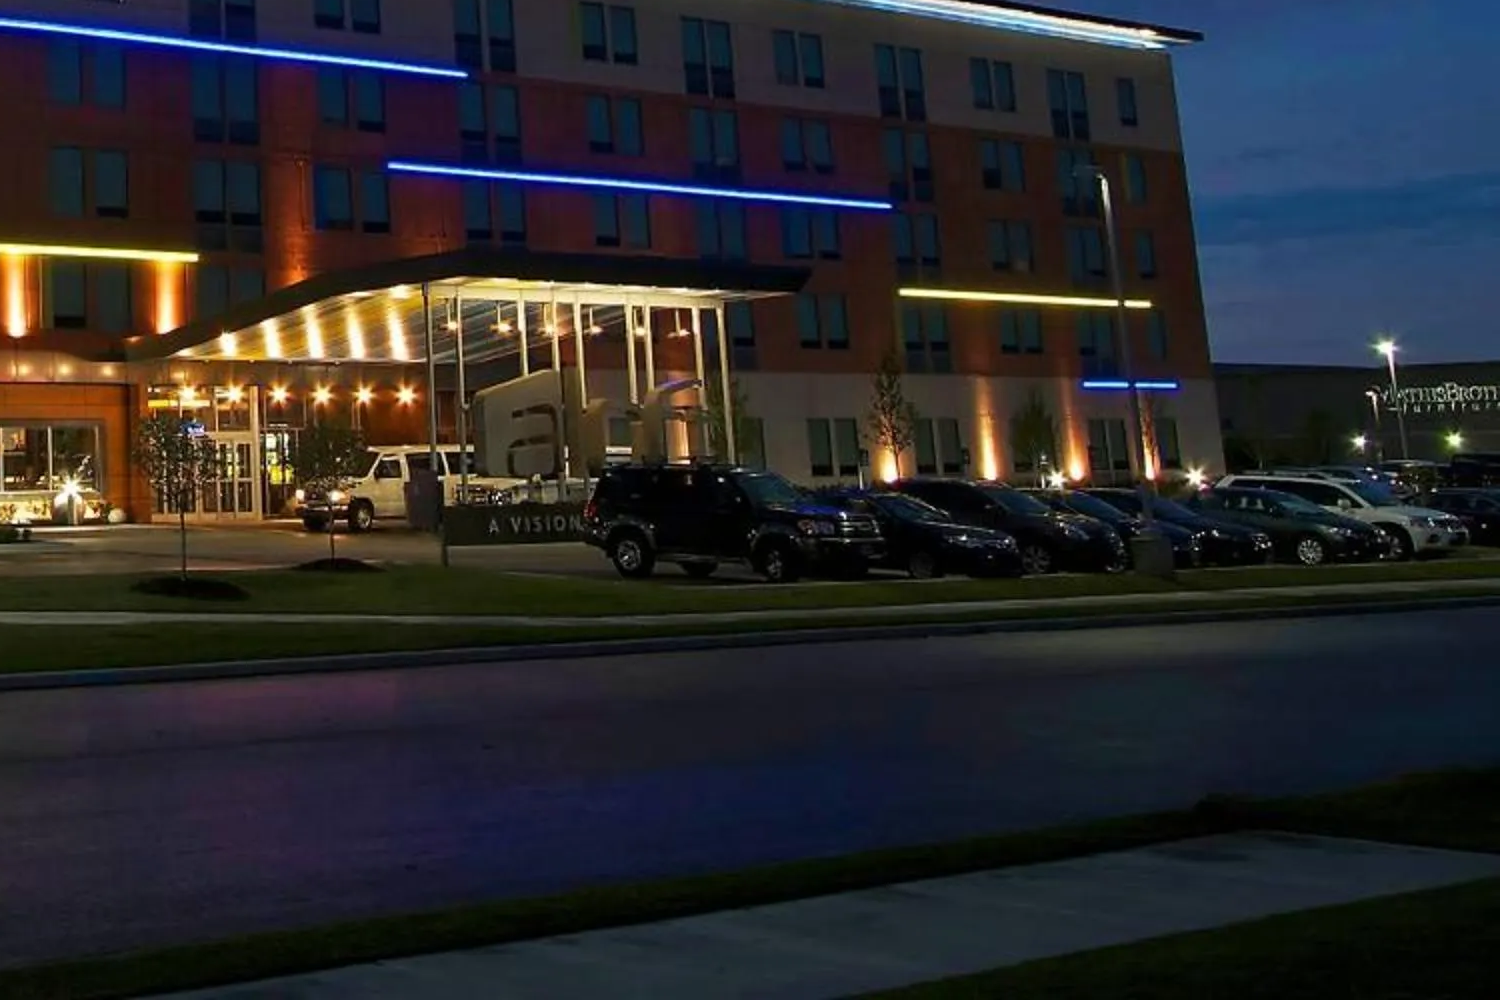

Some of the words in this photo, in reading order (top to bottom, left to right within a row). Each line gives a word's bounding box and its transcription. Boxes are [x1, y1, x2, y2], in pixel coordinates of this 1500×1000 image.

[1403, 400, 1500, 414] furnitur
[489, 517, 499, 534] A
[511, 513, 583, 533] VISION
